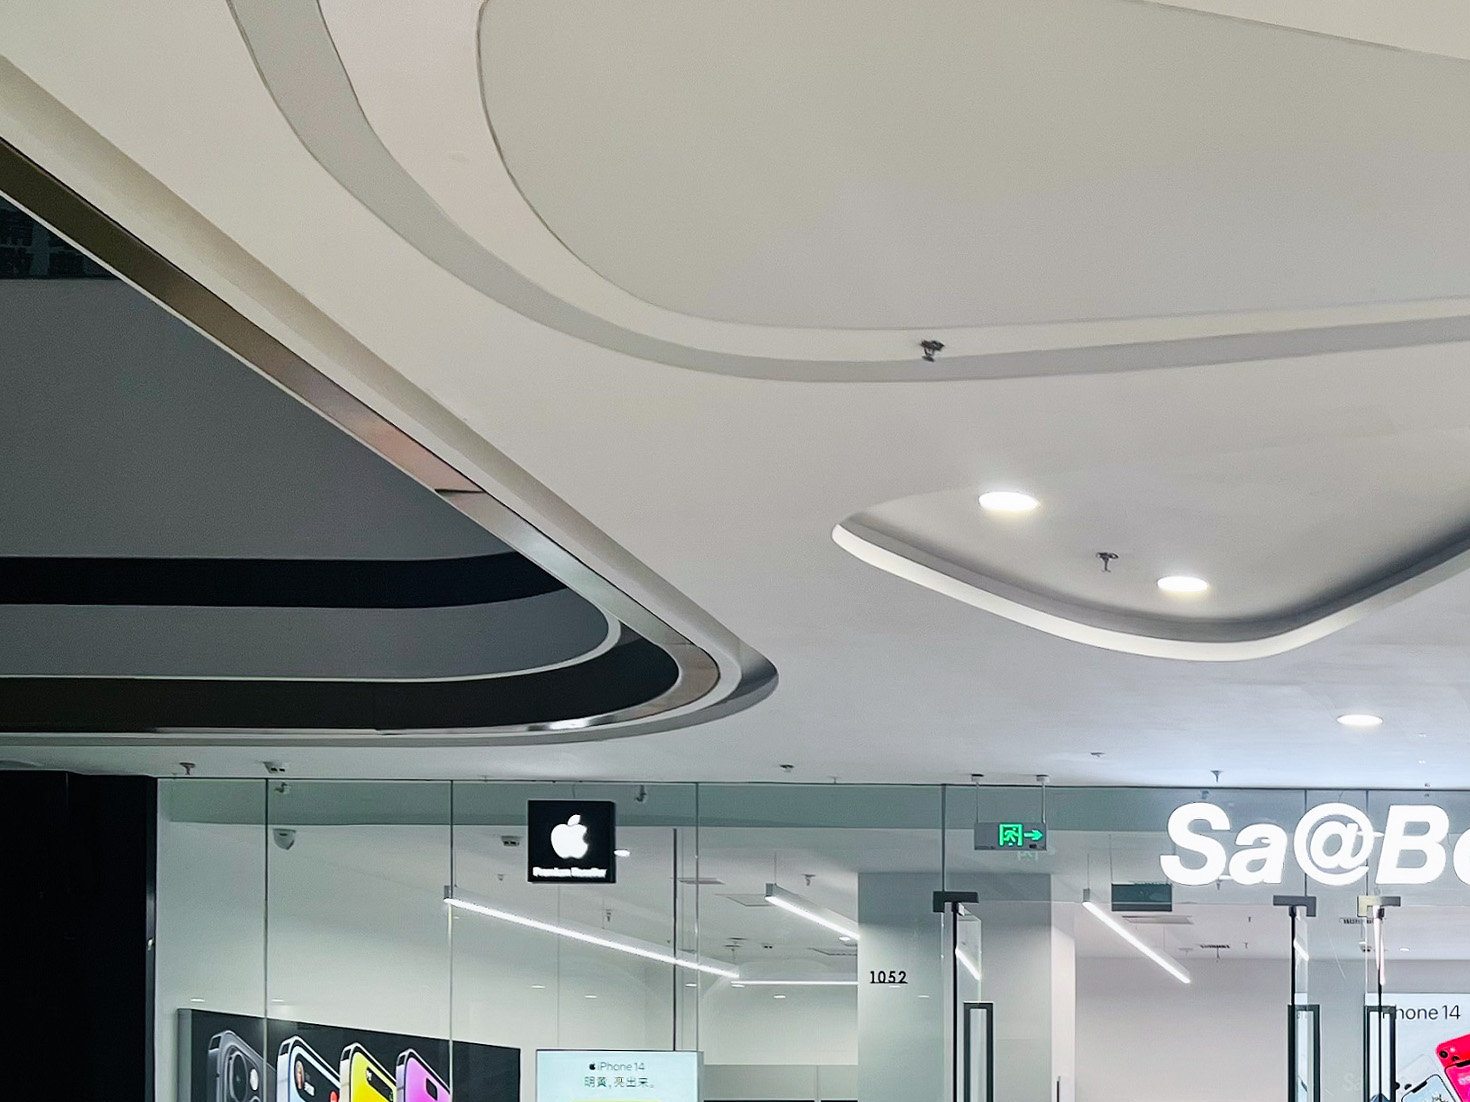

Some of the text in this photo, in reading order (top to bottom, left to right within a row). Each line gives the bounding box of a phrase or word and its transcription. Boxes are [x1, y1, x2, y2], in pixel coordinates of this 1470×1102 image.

[870, 971, 908, 984] 1052
[1442, 1004, 1461, 1019] 14
[597, 1062, 632, 1071] iPhone
